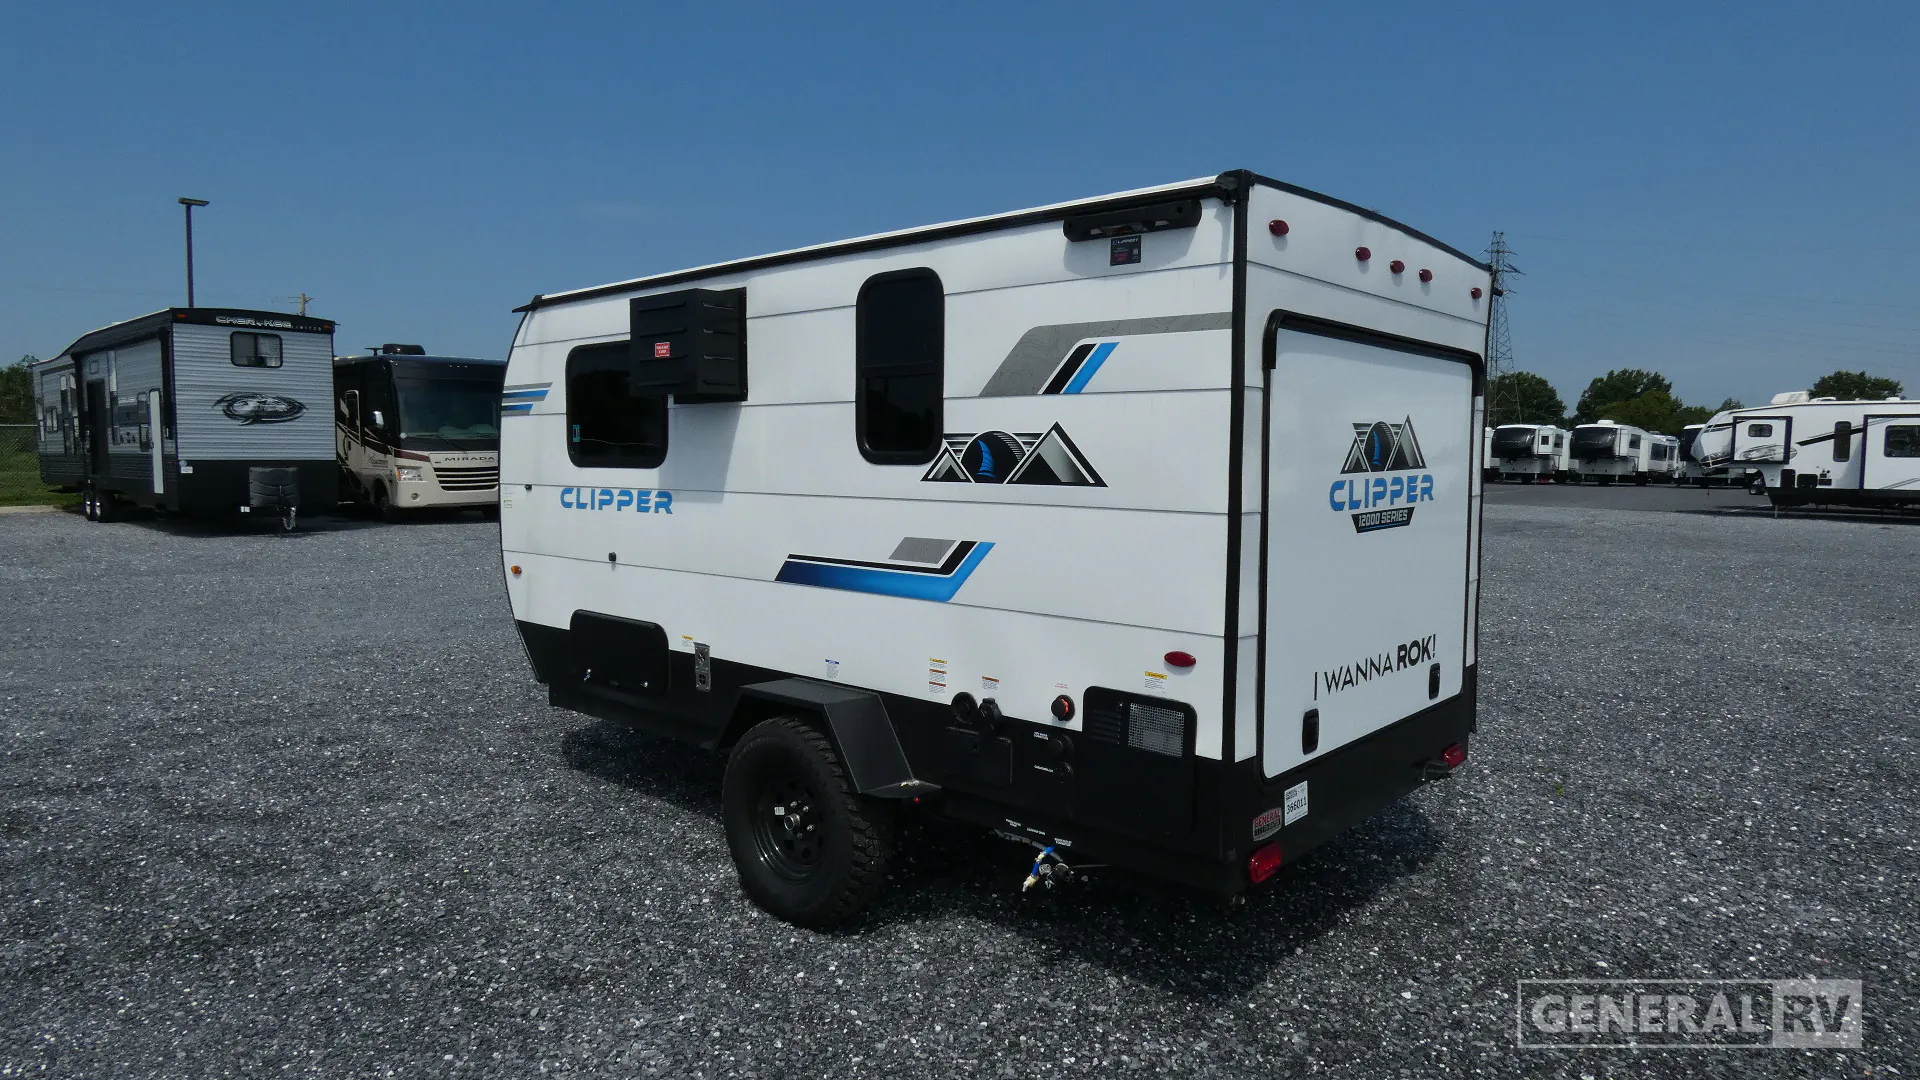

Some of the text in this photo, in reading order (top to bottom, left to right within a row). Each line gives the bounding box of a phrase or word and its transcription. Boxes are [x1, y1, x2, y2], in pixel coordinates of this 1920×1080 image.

[560, 487, 673, 514] CLIPPER
[1329, 474, 1434, 512] CLIPPER
[1358, 509, 1408, 527] 12000 SERIES
[1313, 633, 1437, 702] I WANNA ROK!
